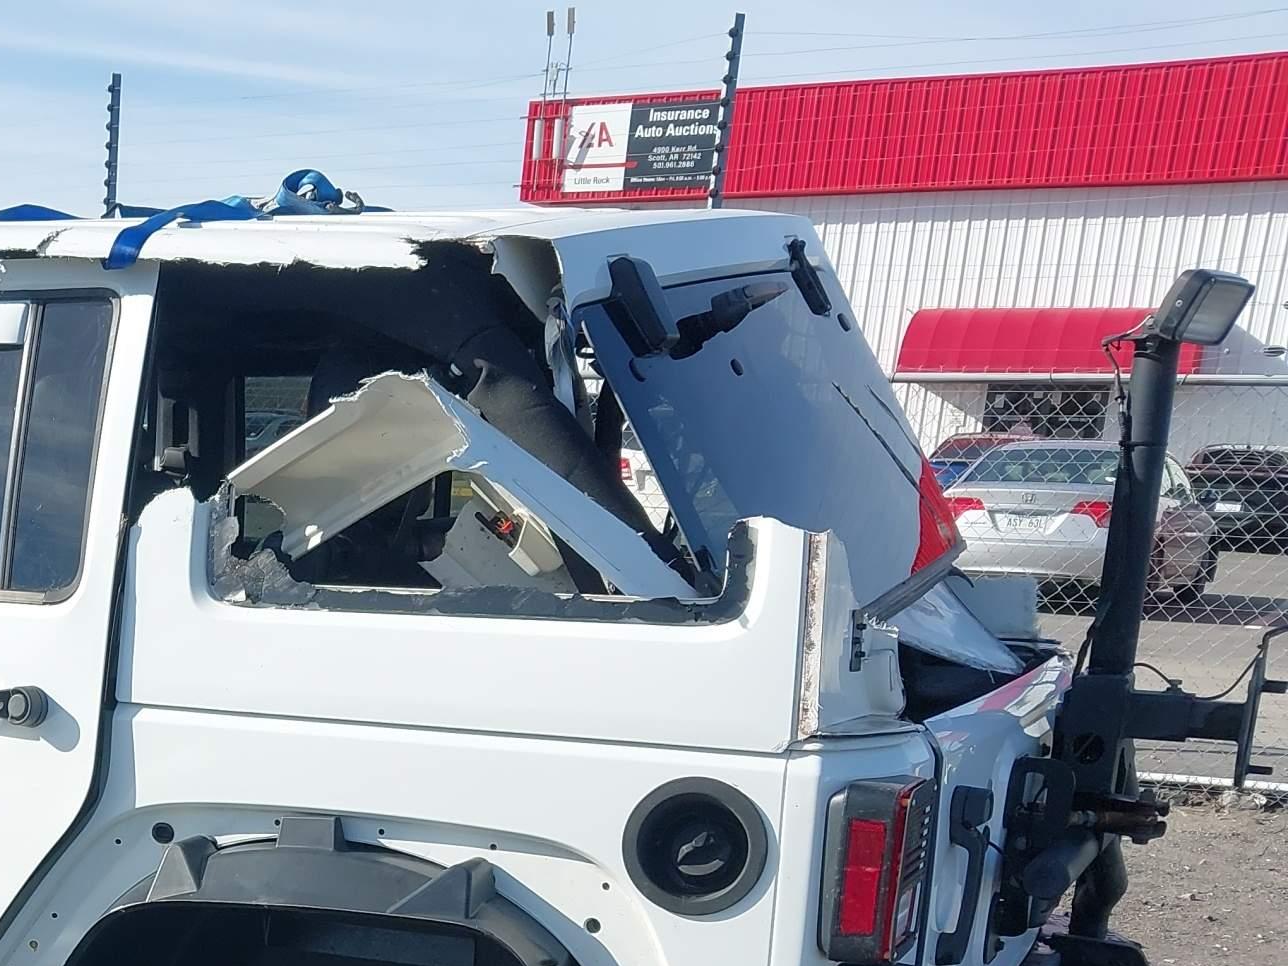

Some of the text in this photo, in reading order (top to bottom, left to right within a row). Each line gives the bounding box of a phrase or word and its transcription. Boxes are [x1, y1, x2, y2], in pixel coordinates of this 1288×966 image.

[649, 107, 710, 121] Insurance
[634, 122, 719, 138] Auto Auctions
[574, 176, 610, 185] Little Rock
[1006, 517, 1025, 528] ASY
